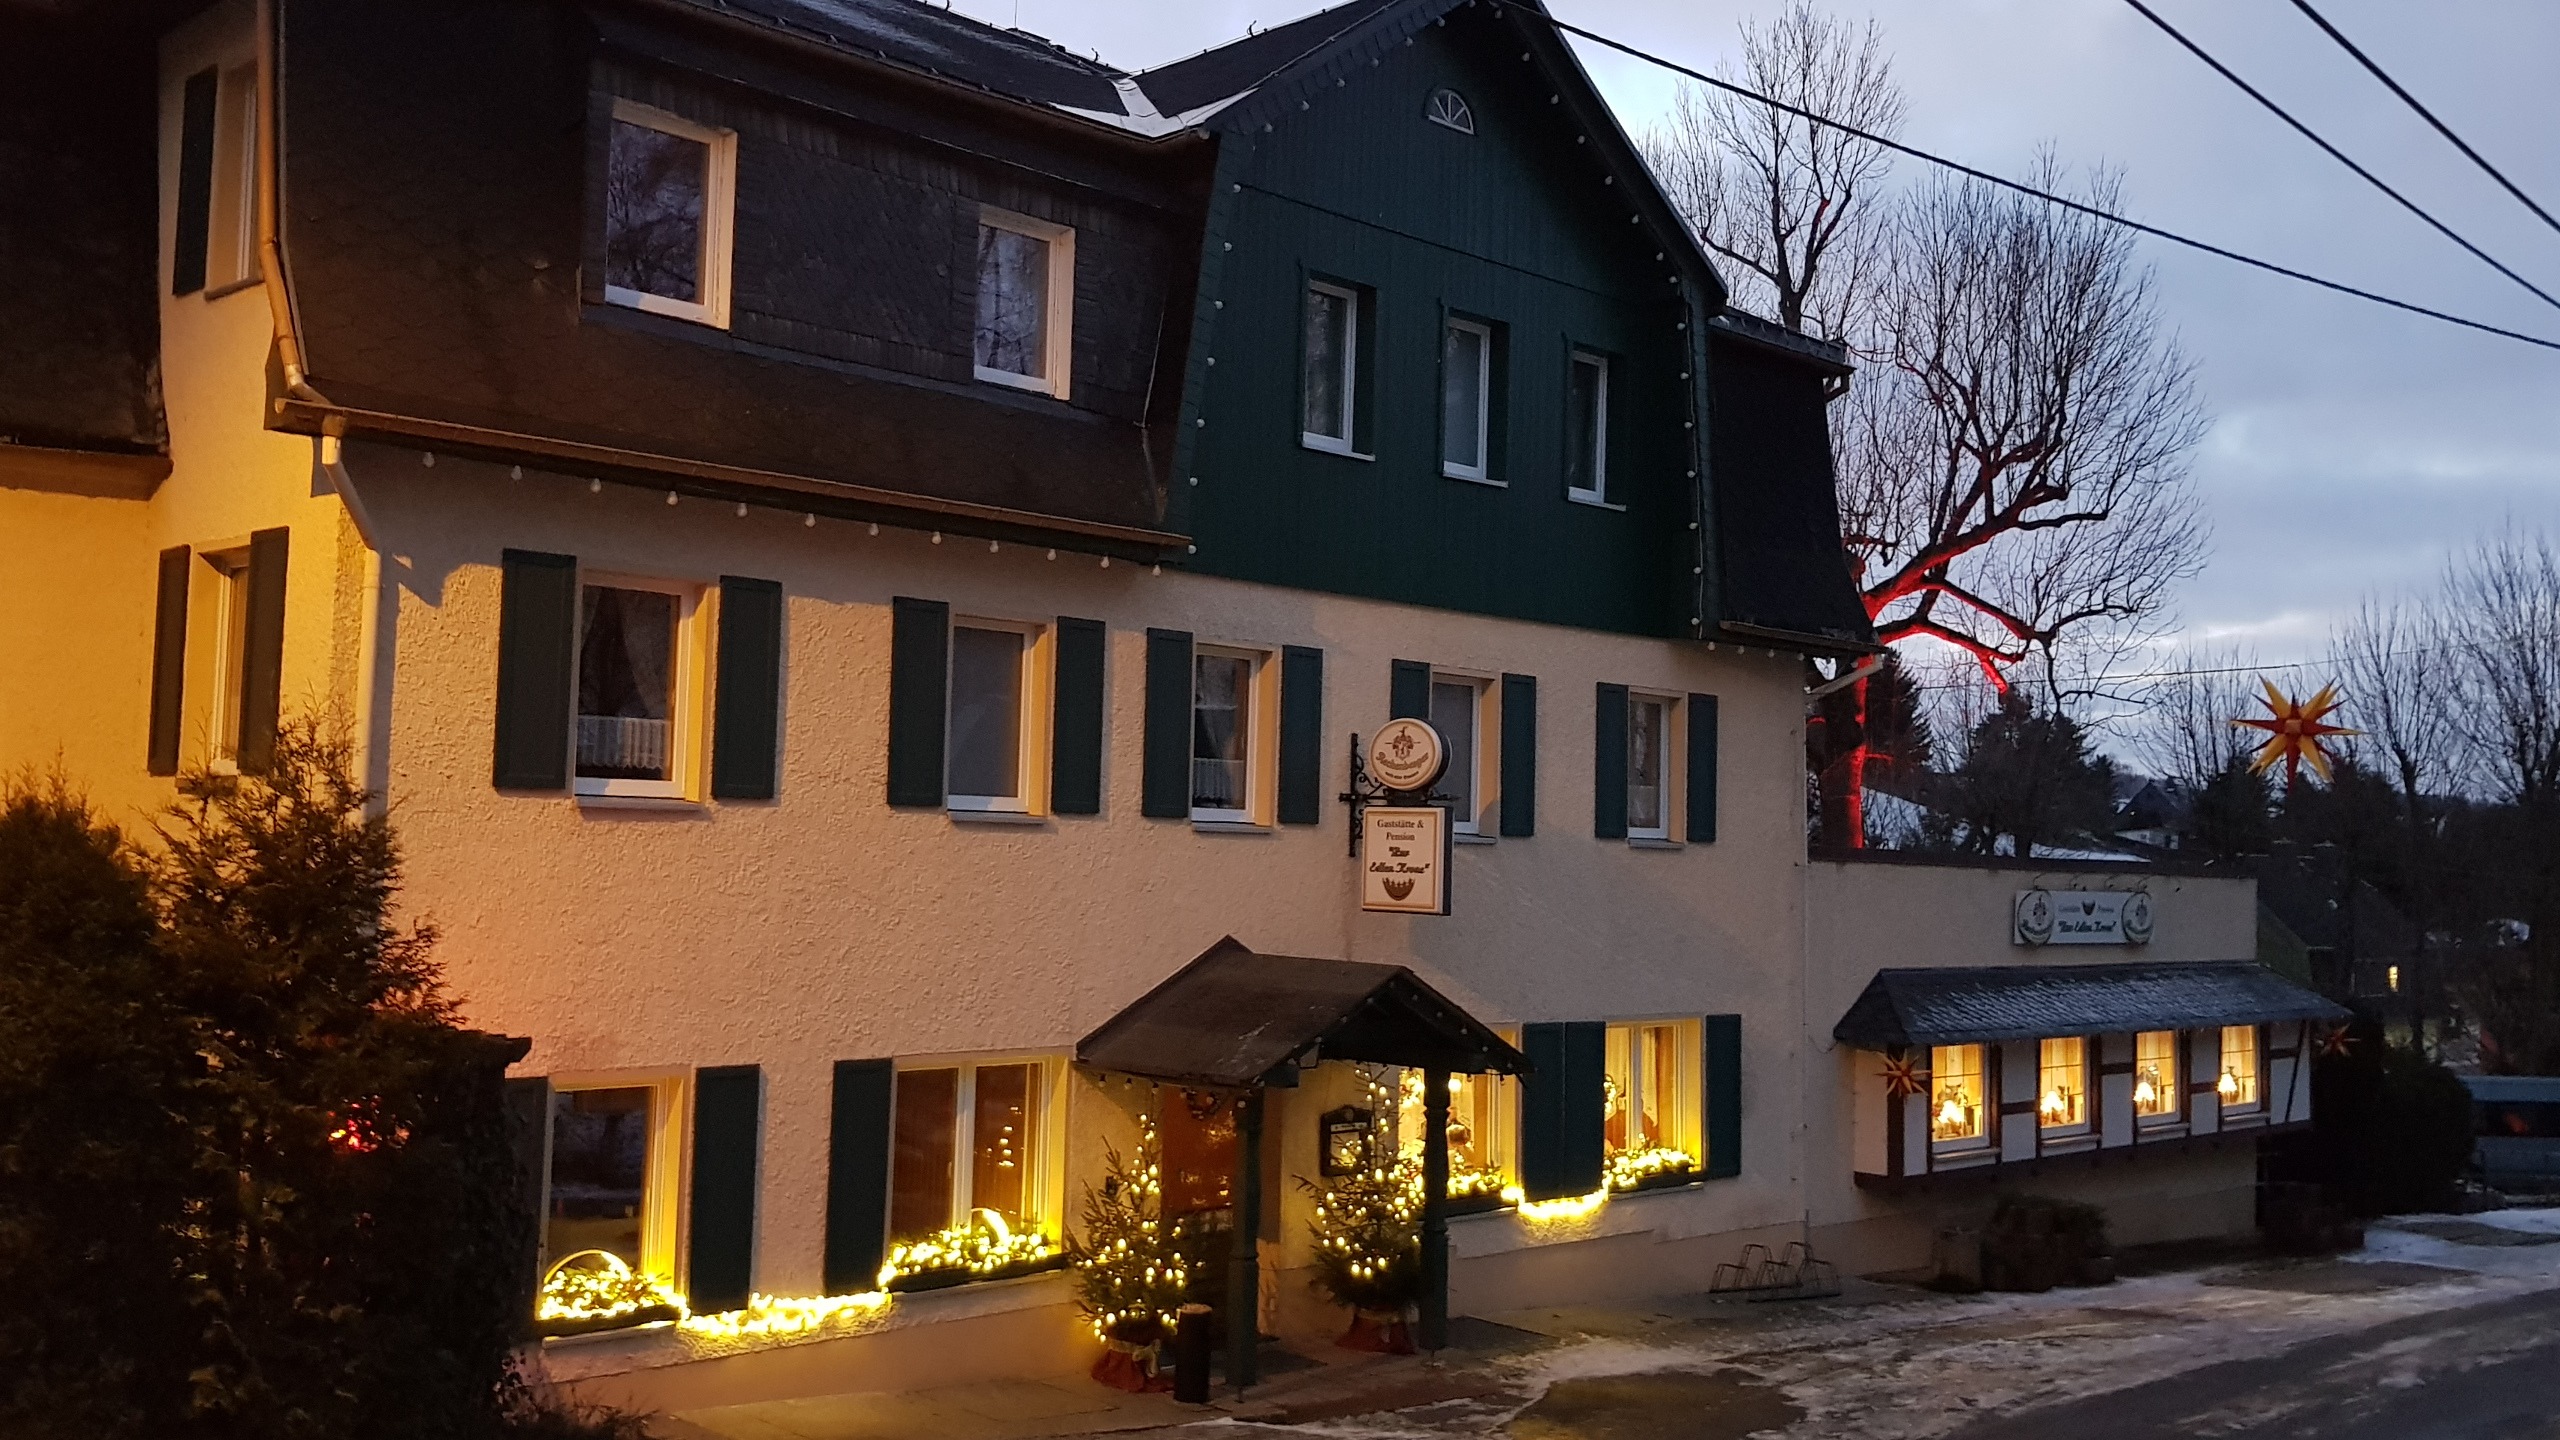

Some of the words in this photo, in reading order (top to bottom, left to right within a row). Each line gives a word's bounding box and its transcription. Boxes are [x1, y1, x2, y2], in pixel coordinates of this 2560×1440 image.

[1377, 819, 1415, 828] Gaststätte
[1417, 819, 1424, 828] &
[1386, 832, 1415, 840] Pension
